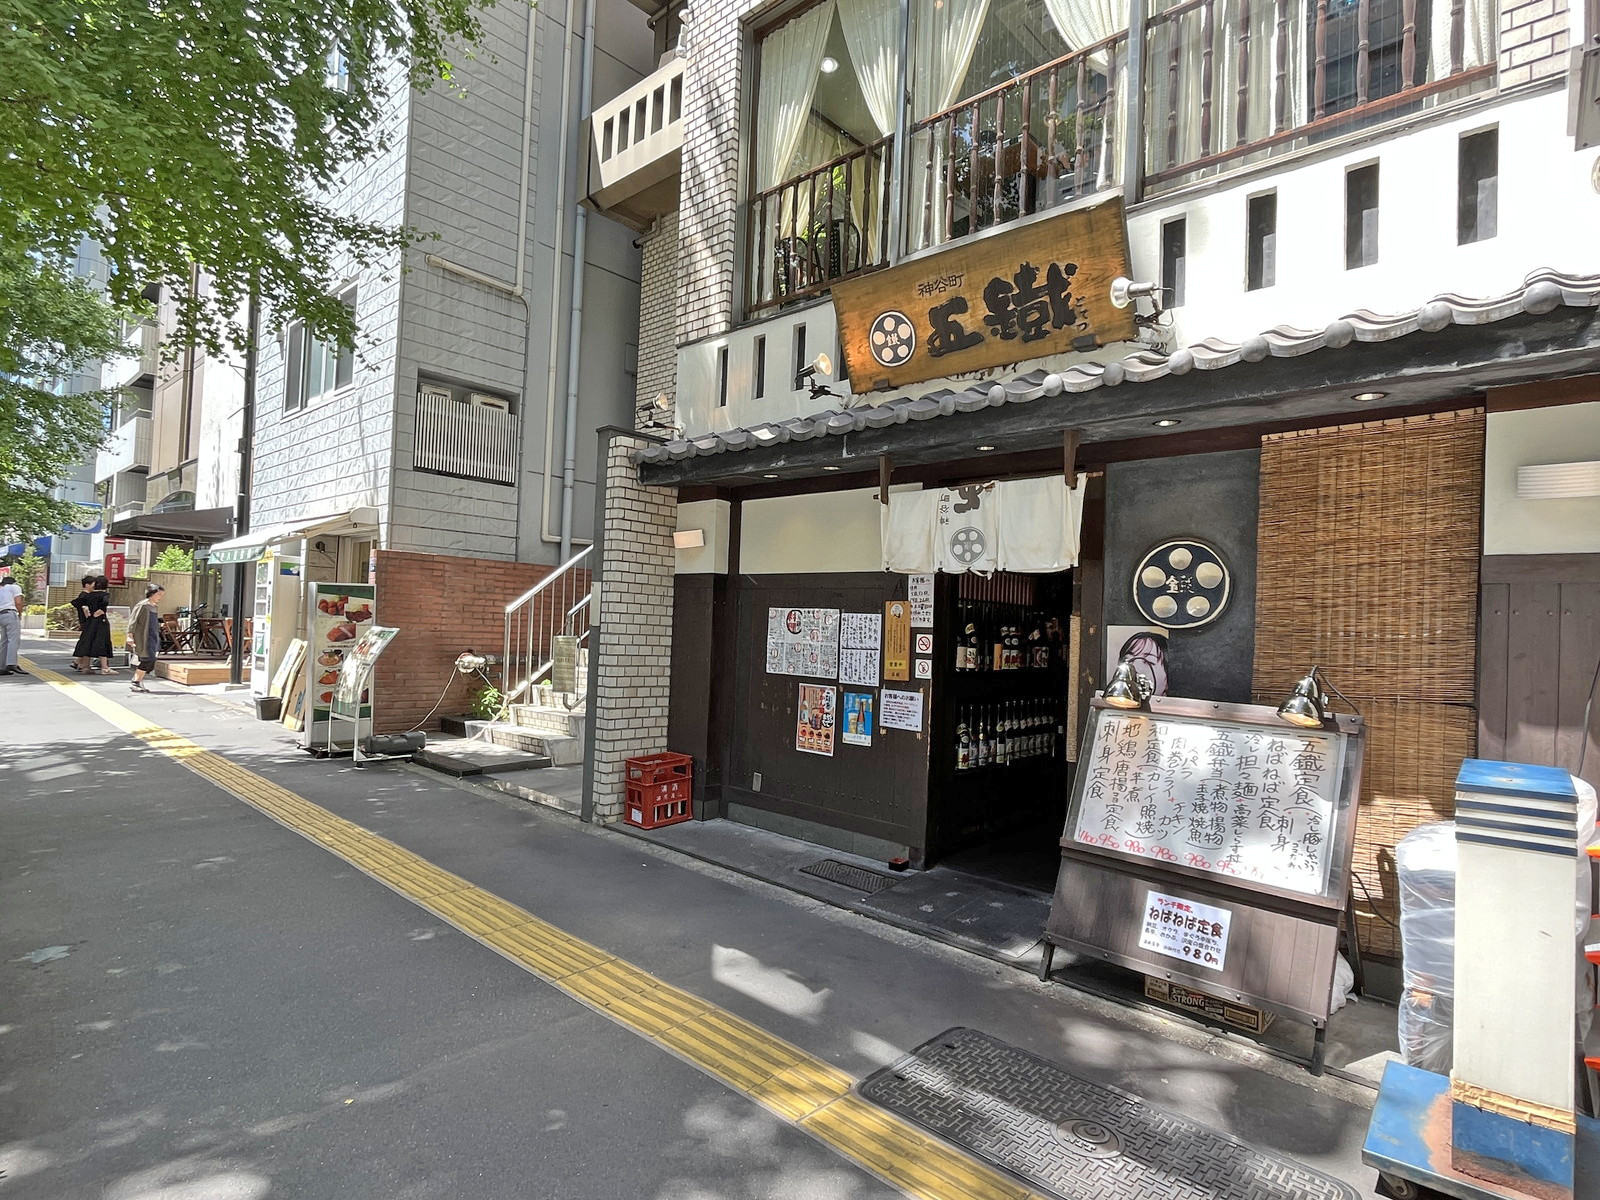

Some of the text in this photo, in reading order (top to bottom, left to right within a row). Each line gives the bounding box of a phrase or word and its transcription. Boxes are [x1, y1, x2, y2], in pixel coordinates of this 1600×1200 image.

[918, 273, 964, 297] 神谷町
[1088, 720, 1121, 800] 刺身定食
[1257, 739, 1288, 831] ねばねば定食
[1098, 833, 1120, 849] 950
[1125, 839, 1146, 855] 980
[1150, 846, 1178, 862] 980
[1184, 853, 1212, 870] 980
[1149, 906, 1224, 938] ねばねば定食
[1182, 945, 1219, 966] 980円
[1172, 994, 1205, 1007] STRONG
[1063, 1134, 1097, 1152] NTT
